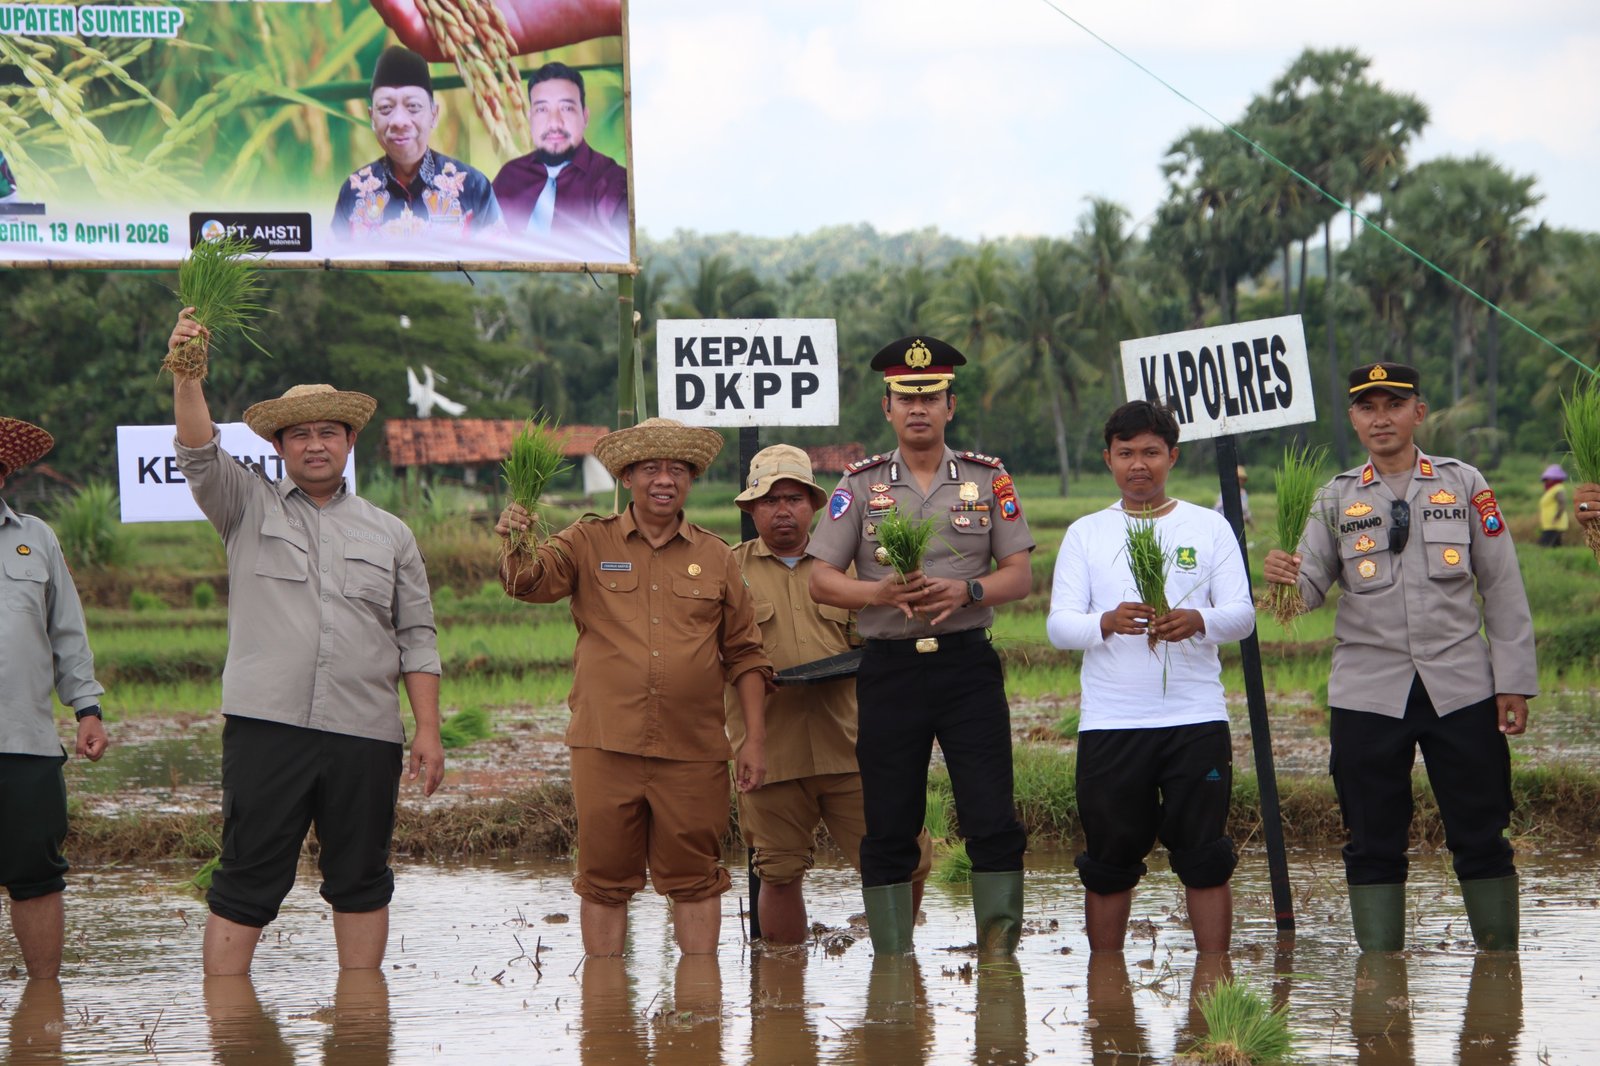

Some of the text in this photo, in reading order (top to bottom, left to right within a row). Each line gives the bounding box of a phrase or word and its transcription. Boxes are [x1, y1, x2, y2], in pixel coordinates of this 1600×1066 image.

[0, 7, 181, 33] UPATEN SUMENEP
[50, 223, 68, 242] 13
[75, 223, 120, 244] April
[126, 224, 169, 243] 2026
[226, 225, 301, 239] PT. AHSTI
[675, 336, 819, 367] KEPALA
[676, 372, 820, 410] DKPP
[1140, 334, 1293, 424] KAPOLRES
[1423, 508, 1466, 521] POLRI
